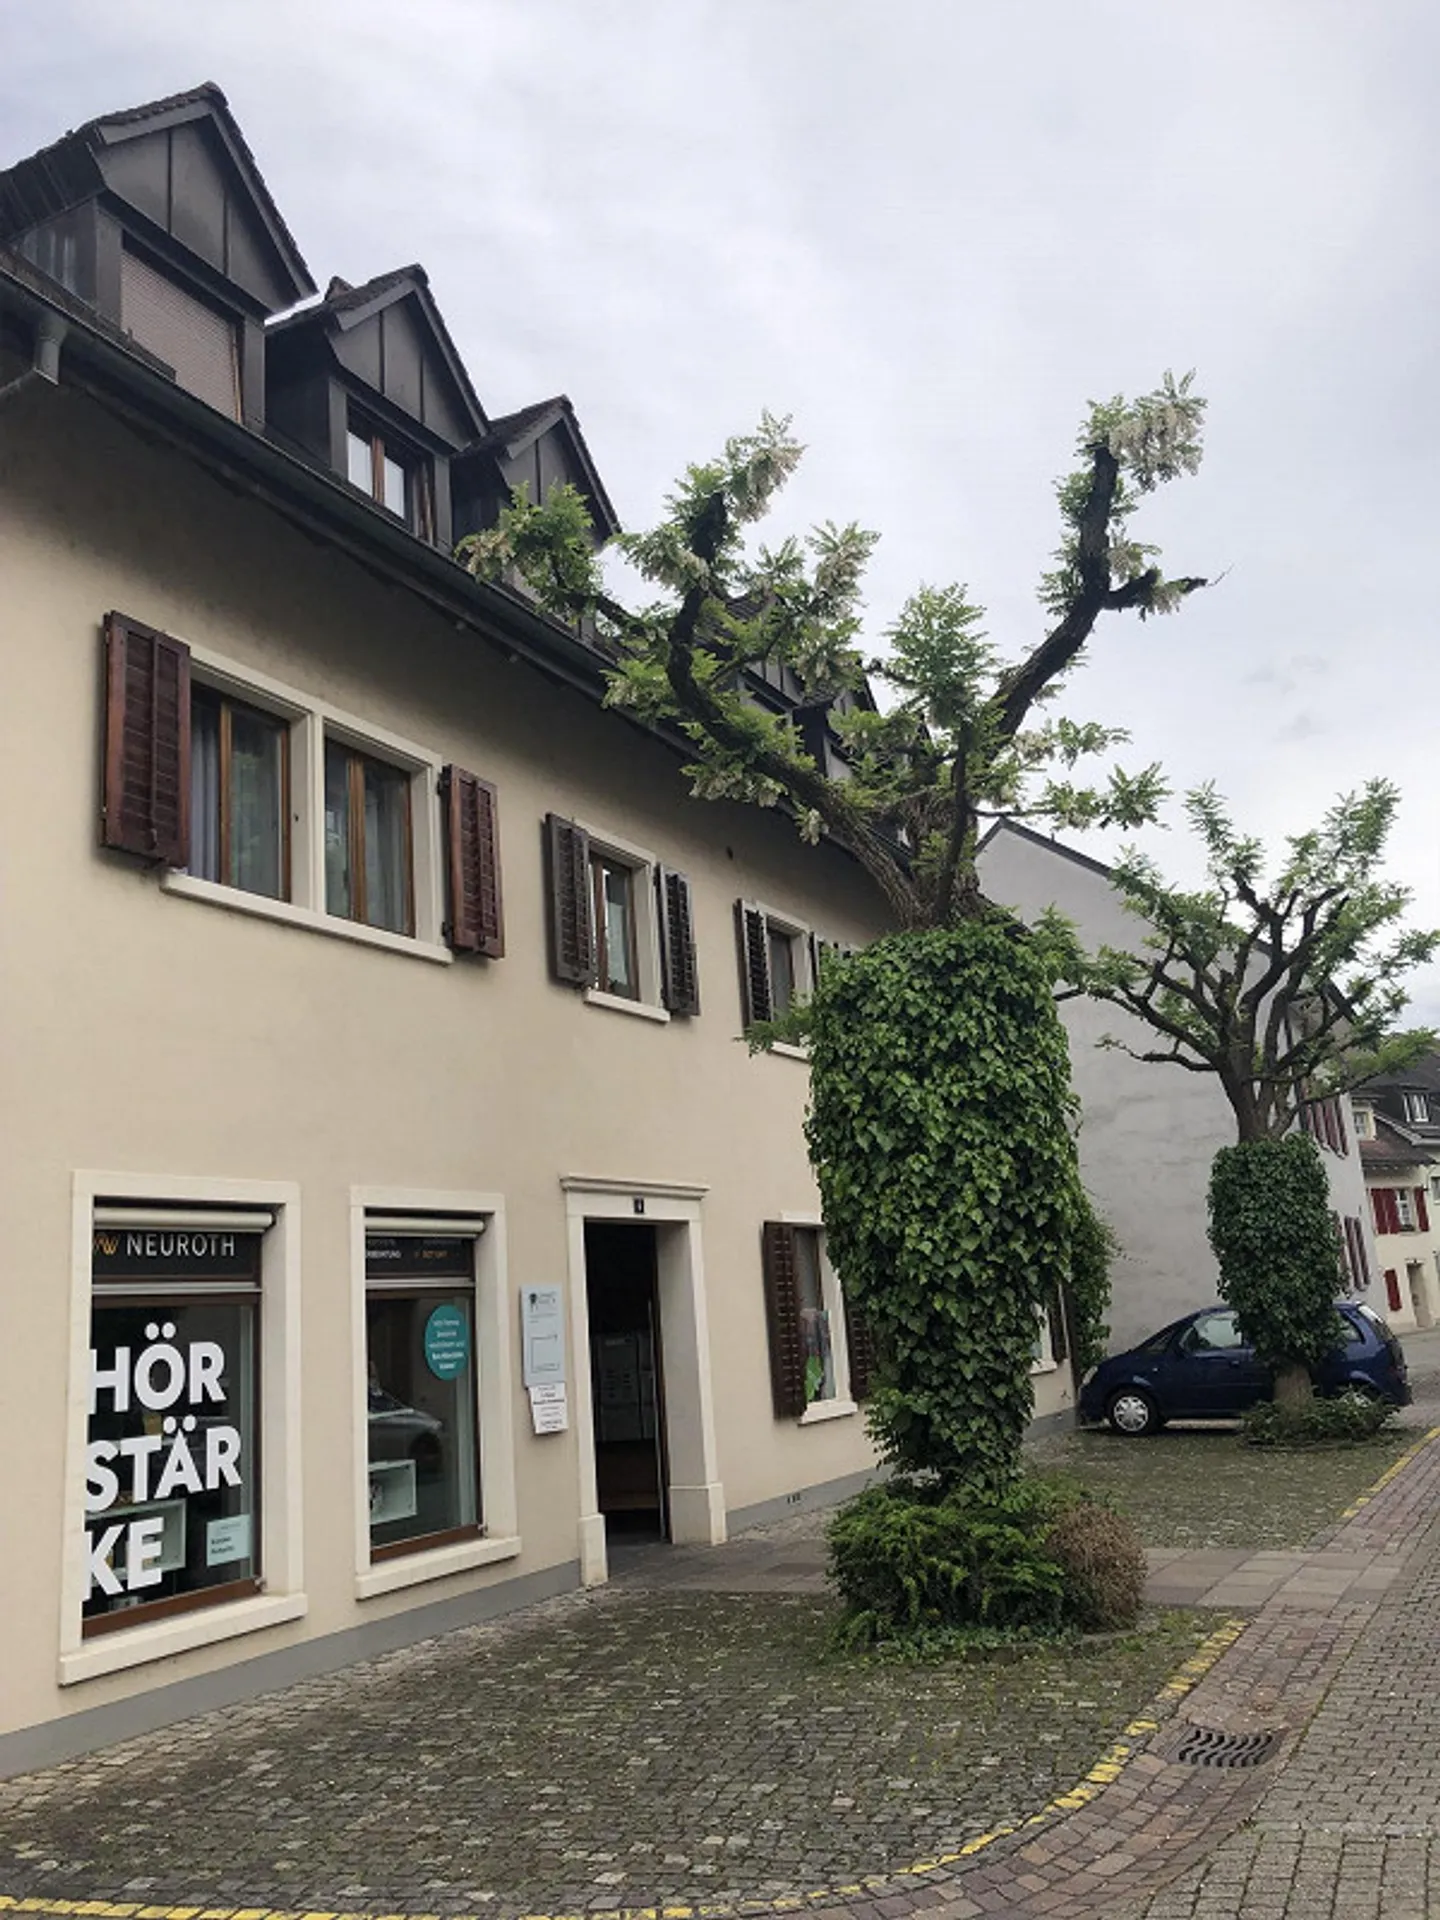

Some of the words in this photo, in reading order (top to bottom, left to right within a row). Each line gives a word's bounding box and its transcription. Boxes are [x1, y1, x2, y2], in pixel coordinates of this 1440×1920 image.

[126, 1233, 236, 1257] NEUROTH
[87, 1321, 227, 1416] HÖR
[84, 1414, 243, 1514] STÄR
[82, 1516, 165, 1602] KE
